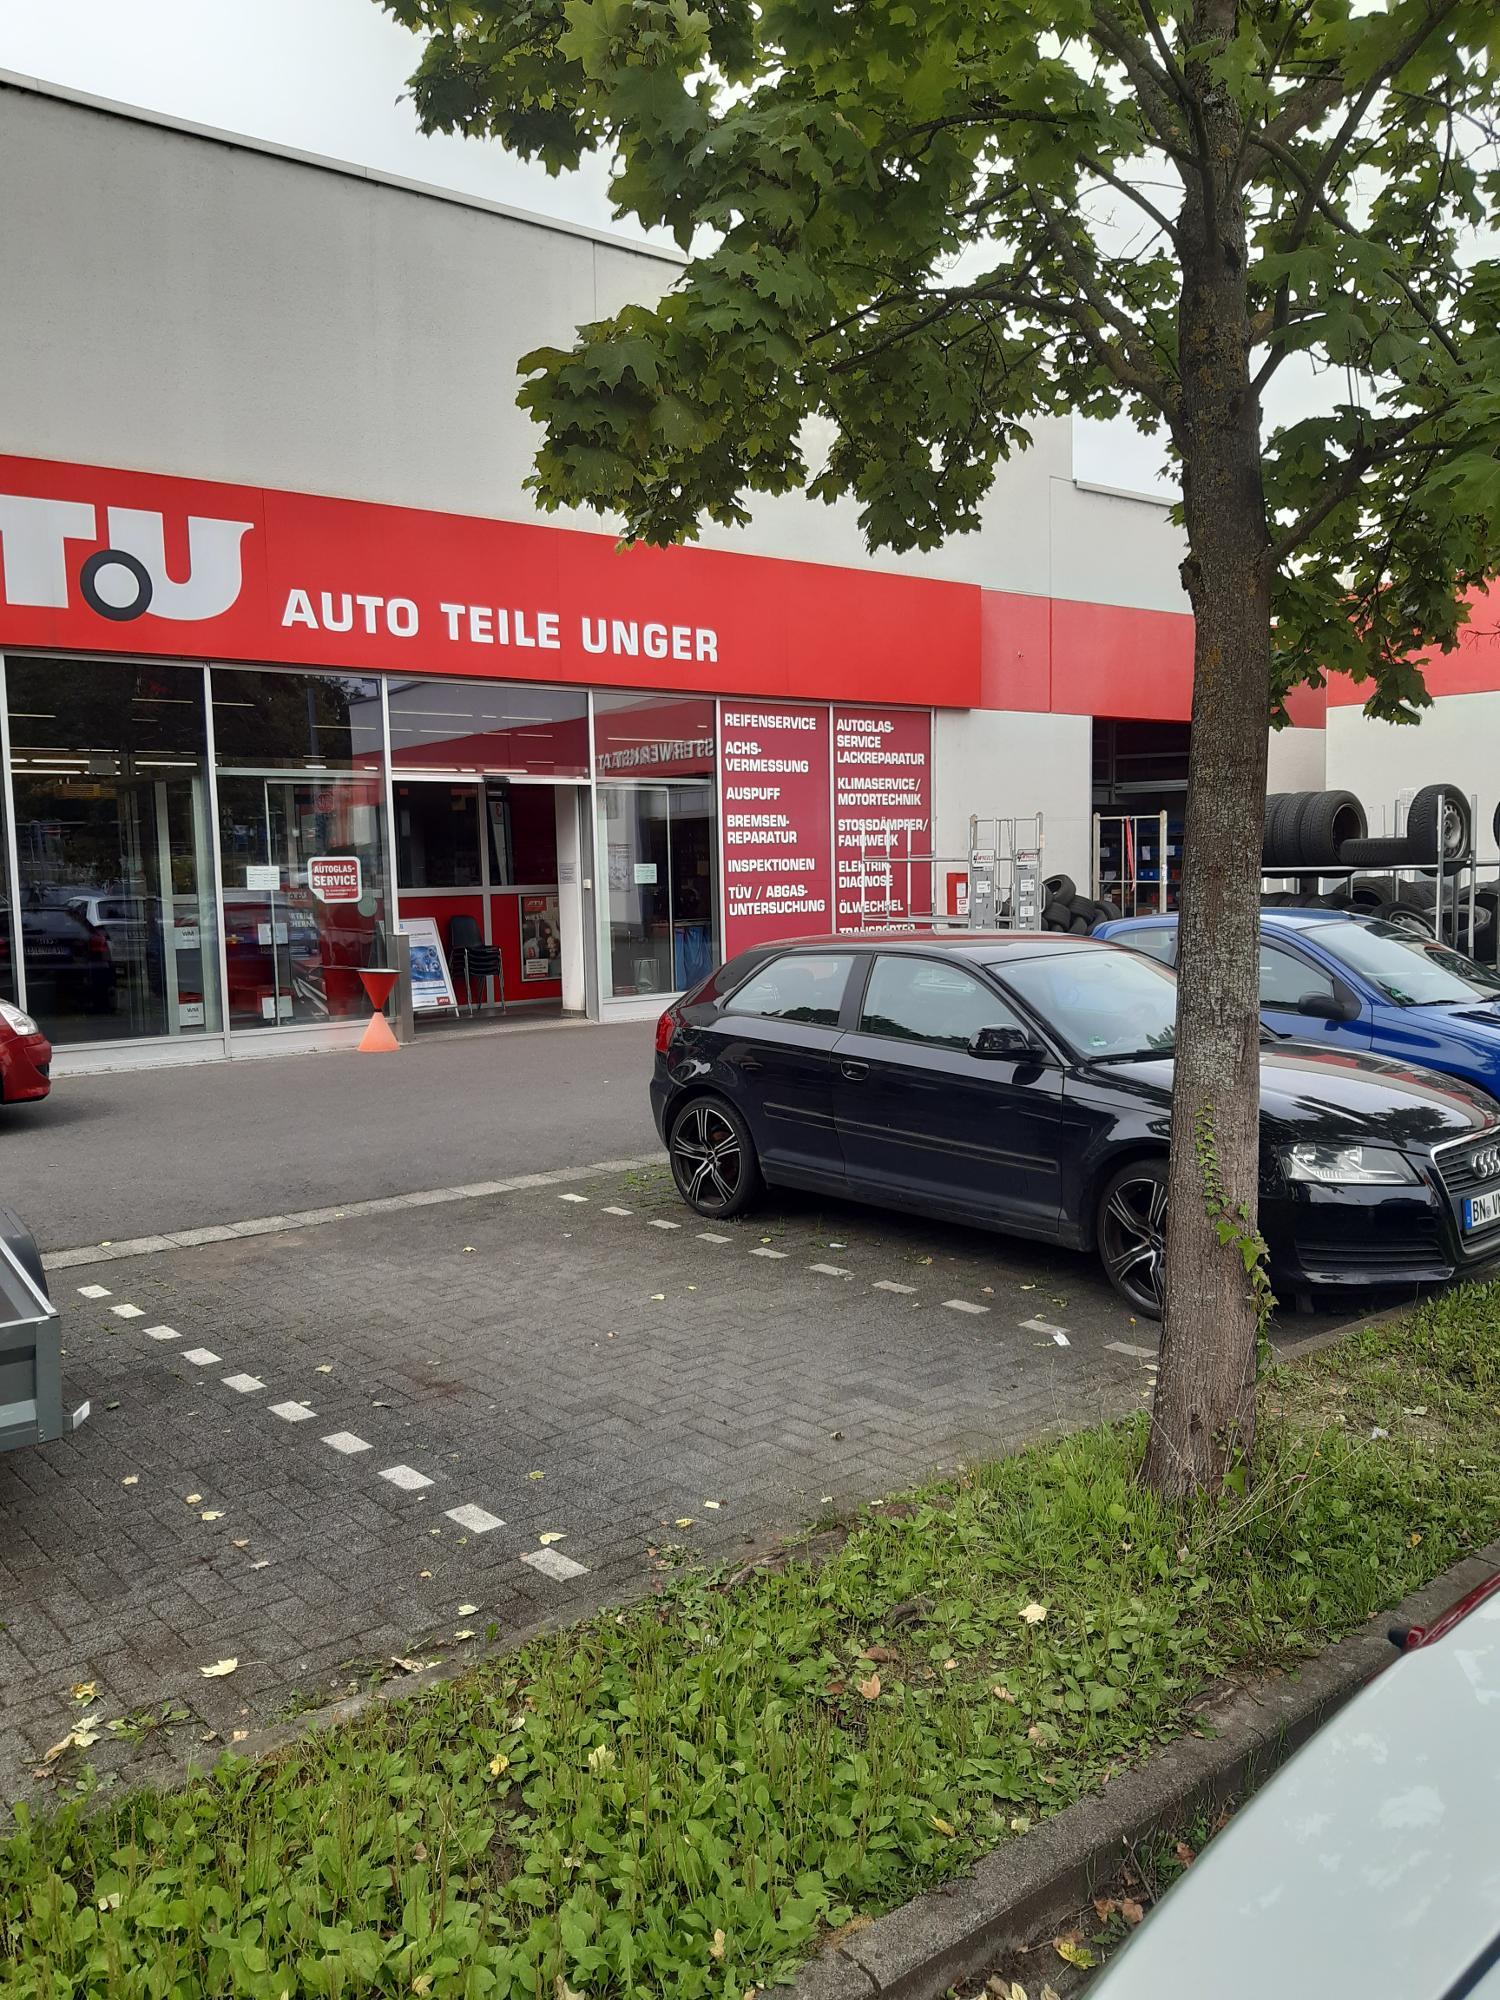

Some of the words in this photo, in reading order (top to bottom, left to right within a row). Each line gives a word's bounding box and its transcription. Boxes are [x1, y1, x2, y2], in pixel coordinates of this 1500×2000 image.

[0, 494, 254, 621] TU
[281, 588, 419, 637] AUTO
[440, 602, 561, 649] TEILE
[581, 616, 718, 662] UNGER
[725, 713, 816, 730] REIFENSERVICE
[837, 719, 894, 733] AUTOGLAS-
[725, 741, 762, 755] ACHS-
[837, 735, 881, 748] SERVICE
[837, 751, 925, 765] LACKREPARATUR
[725, 758, 809, 773] VERMESSUNG
[837, 777, 921, 792] KLIMASERVICE/
[726, 787, 781, 800] AUSPUFF
[837, 793, 921, 806] MOTORTECHNIK
[727, 815, 790, 827] BREMSEN-
[727, 831, 797, 844] REPARATUR
[314, 865, 355, 874] AUTOGLAS-
[728, 858, 815, 872] INSPEKTIONEN
[314, 874, 357, 886] SERVICE
[728, 883, 752, 899] TÜV
[755, 886, 762, 899] /
[766, 884, 808, 898] ABGAS-
[729, 900, 825, 916] UNTERSUCHUNG
[839, 899, 904, 913] ÖLWECHSEL
[1473, 1198, 1486, 1222] BN
